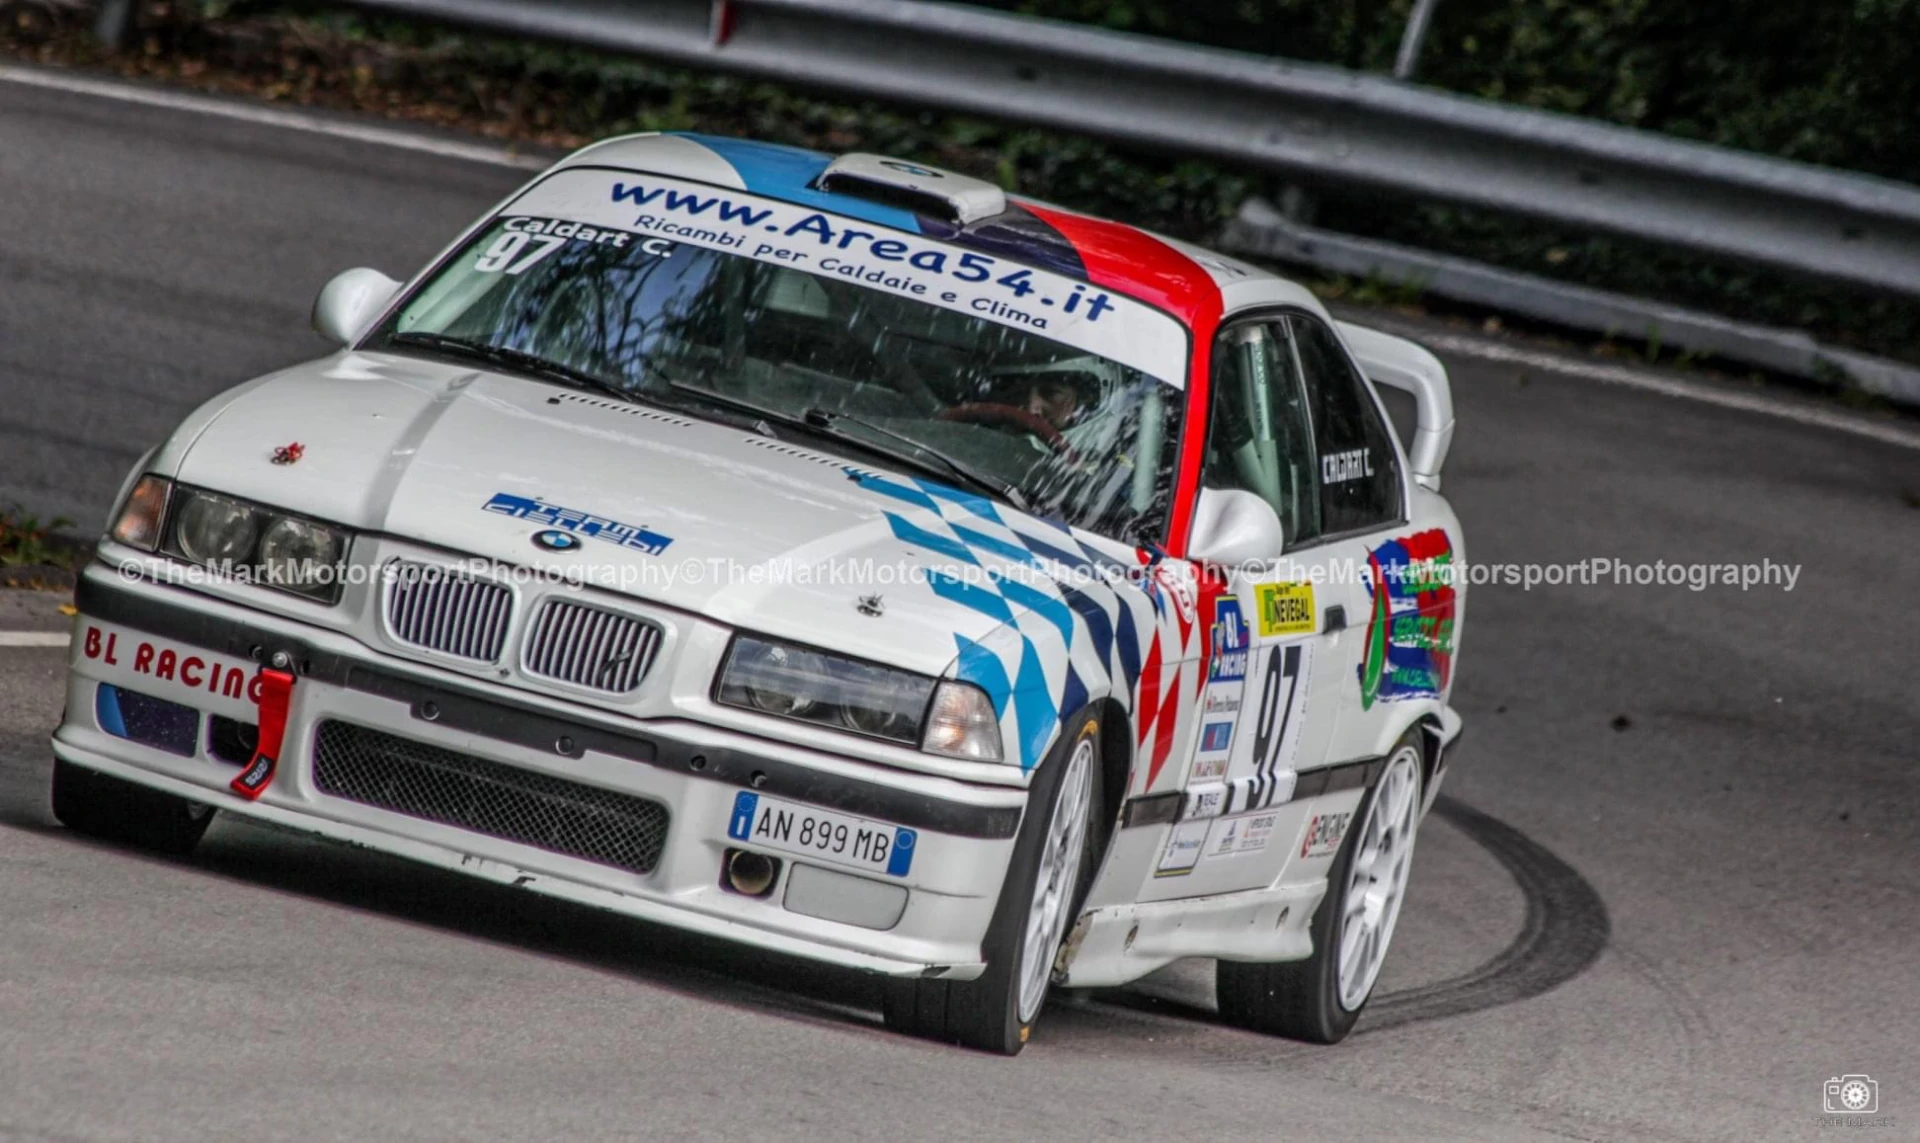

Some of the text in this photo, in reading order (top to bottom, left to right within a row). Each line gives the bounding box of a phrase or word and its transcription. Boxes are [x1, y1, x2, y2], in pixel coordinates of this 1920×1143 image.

[474, 231, 568, 276] 97
[503, 217, 672, 258] Caldart C.
[611, 181, 1115, 322] www.Area54.it
[634, 214, 1048, 331] Ricambi per Caldaie e Clima
[1275, 598, 1310, 623] NEVEGAL
[85, 626, 117, 665] BL
[1247, 644, 1302, 810] 97
[756, 807, 889, 863] AN 899 MB
